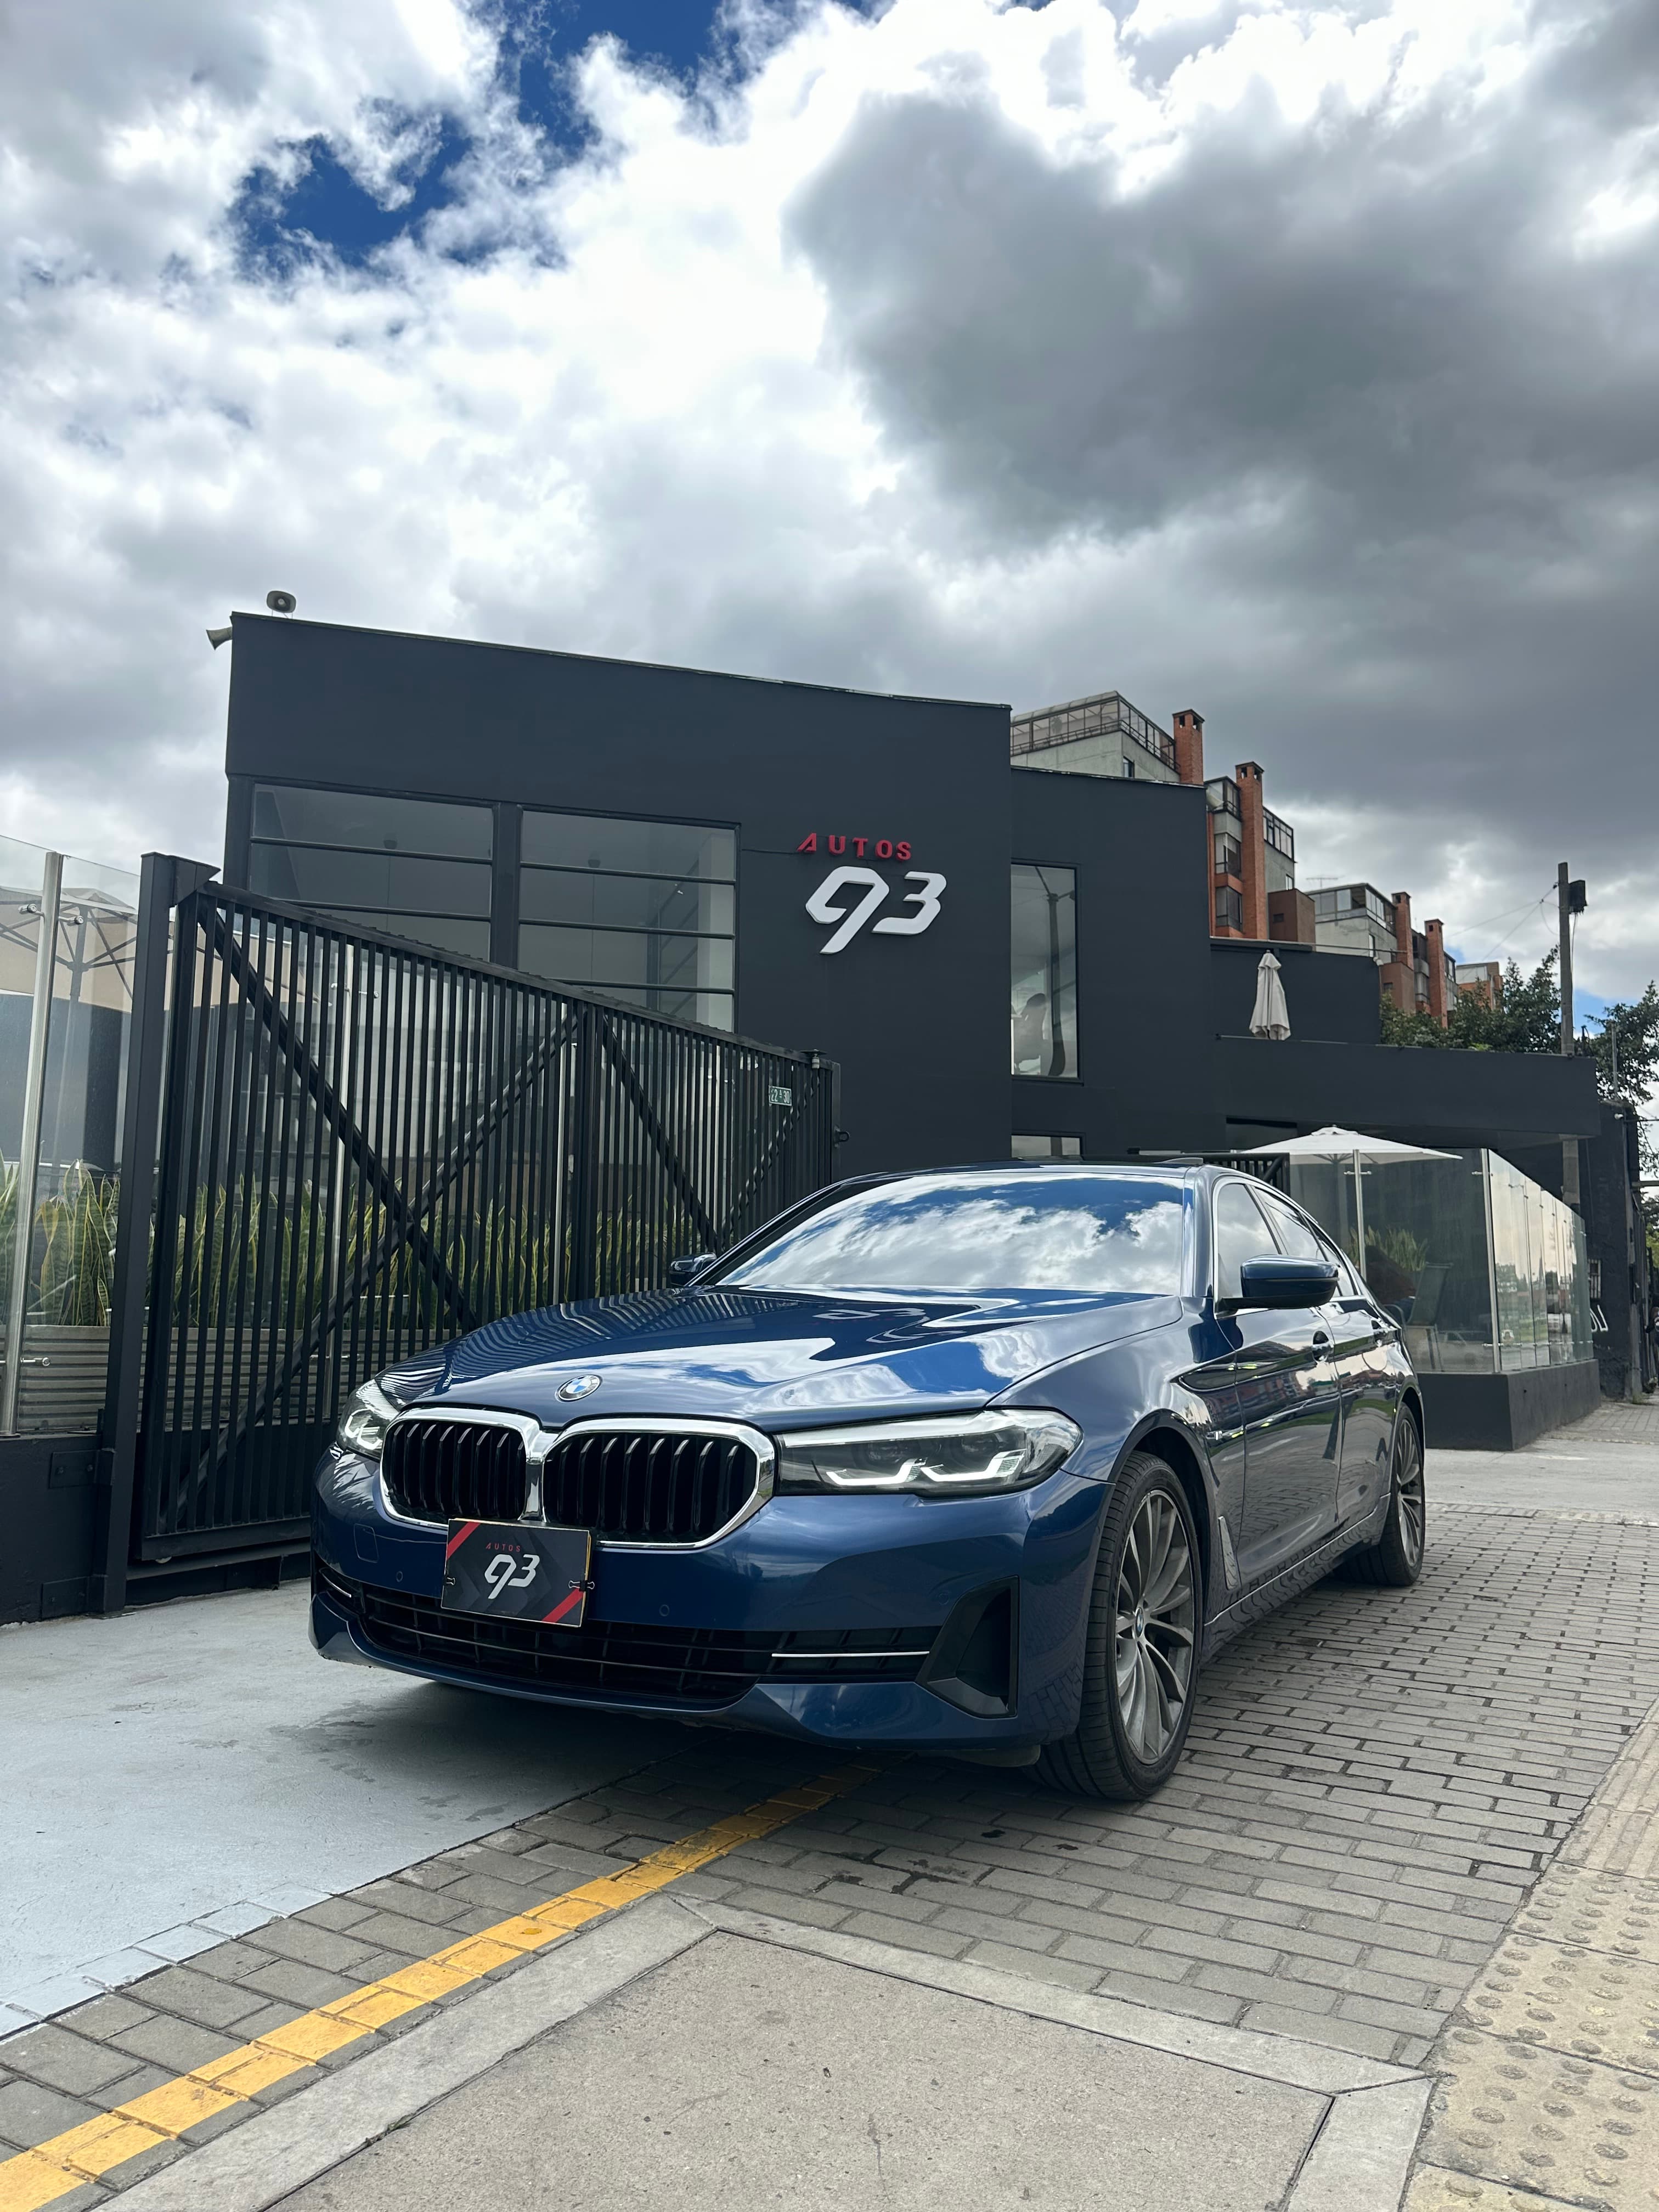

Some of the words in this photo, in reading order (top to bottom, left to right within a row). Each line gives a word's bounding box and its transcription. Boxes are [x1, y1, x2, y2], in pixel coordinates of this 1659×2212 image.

[797, 833, 911, 861] AUTOS
[805, 865, 947, 955] 93
[486, 1542, 521, 1553] AUTOS
[484, 1554, 540, 1600] 93
